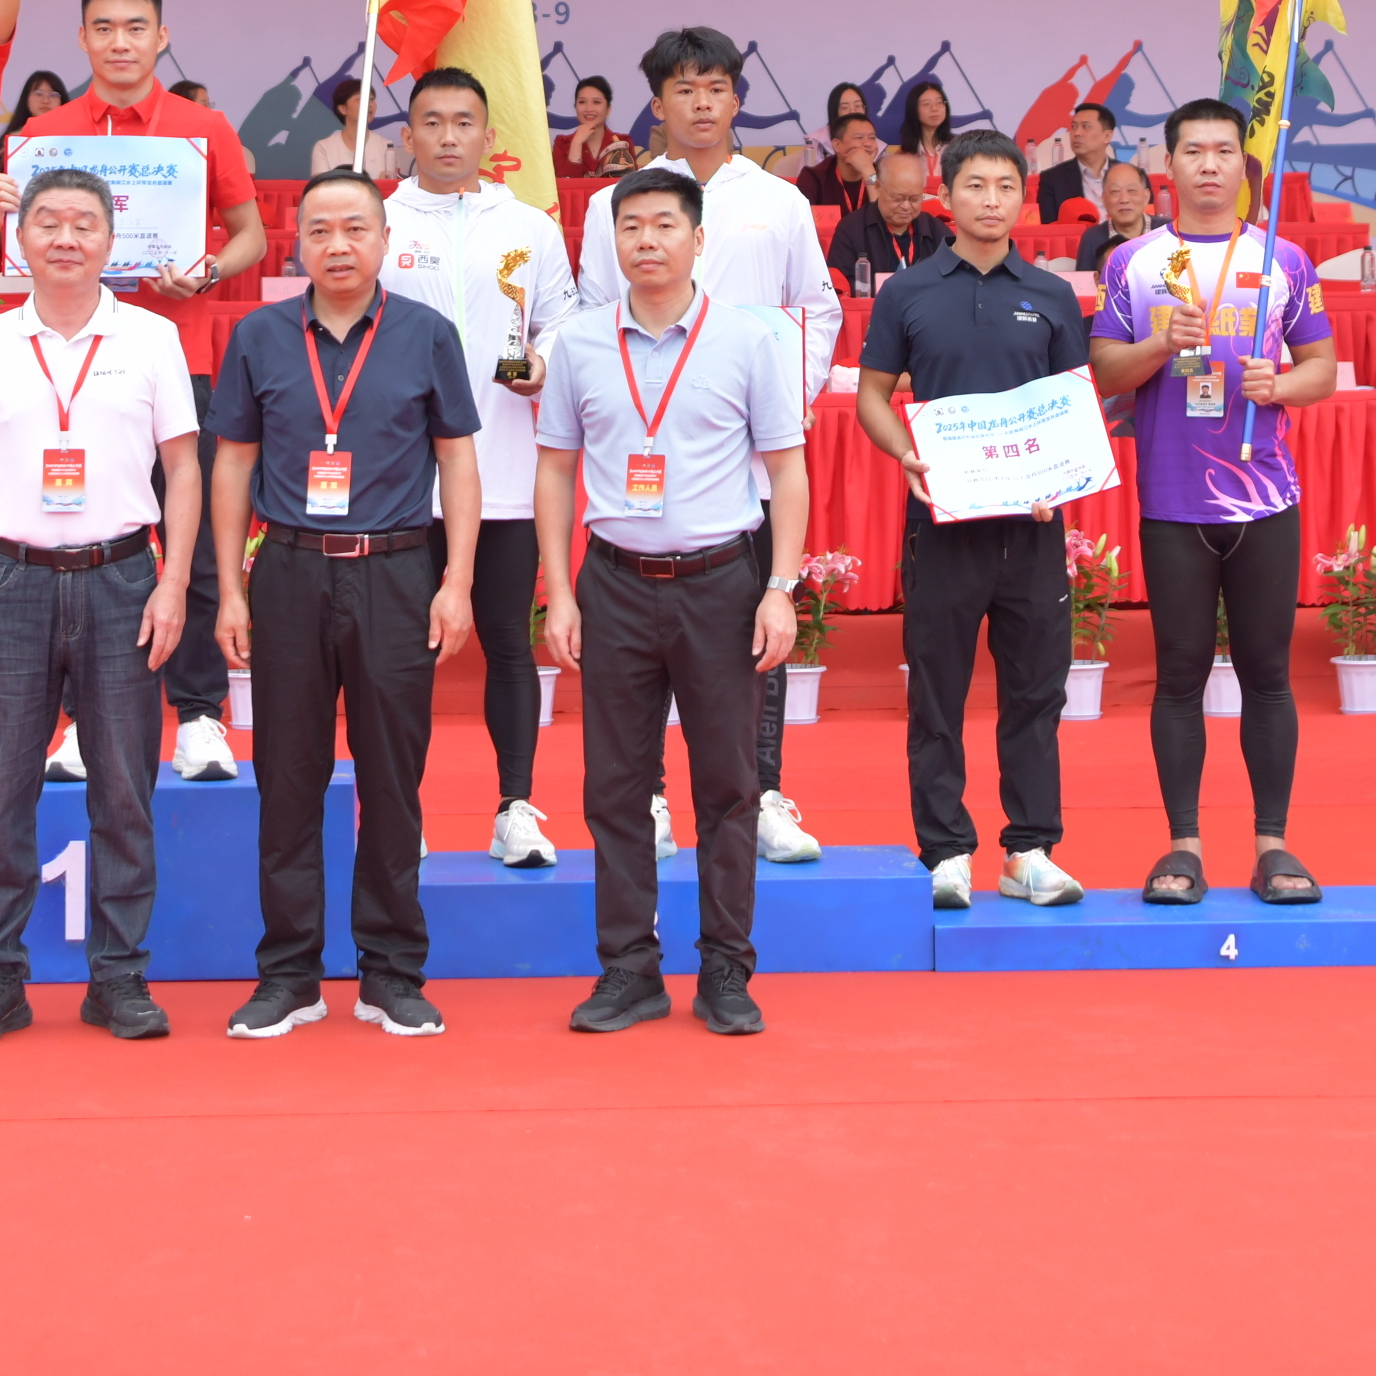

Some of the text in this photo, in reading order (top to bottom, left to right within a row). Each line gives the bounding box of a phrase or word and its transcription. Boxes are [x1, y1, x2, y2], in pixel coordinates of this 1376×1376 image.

[981, 437, 1041, 460] 第四名
[40, 840, 88, 942] 1
[1219, 933, 1238, 961] 4
